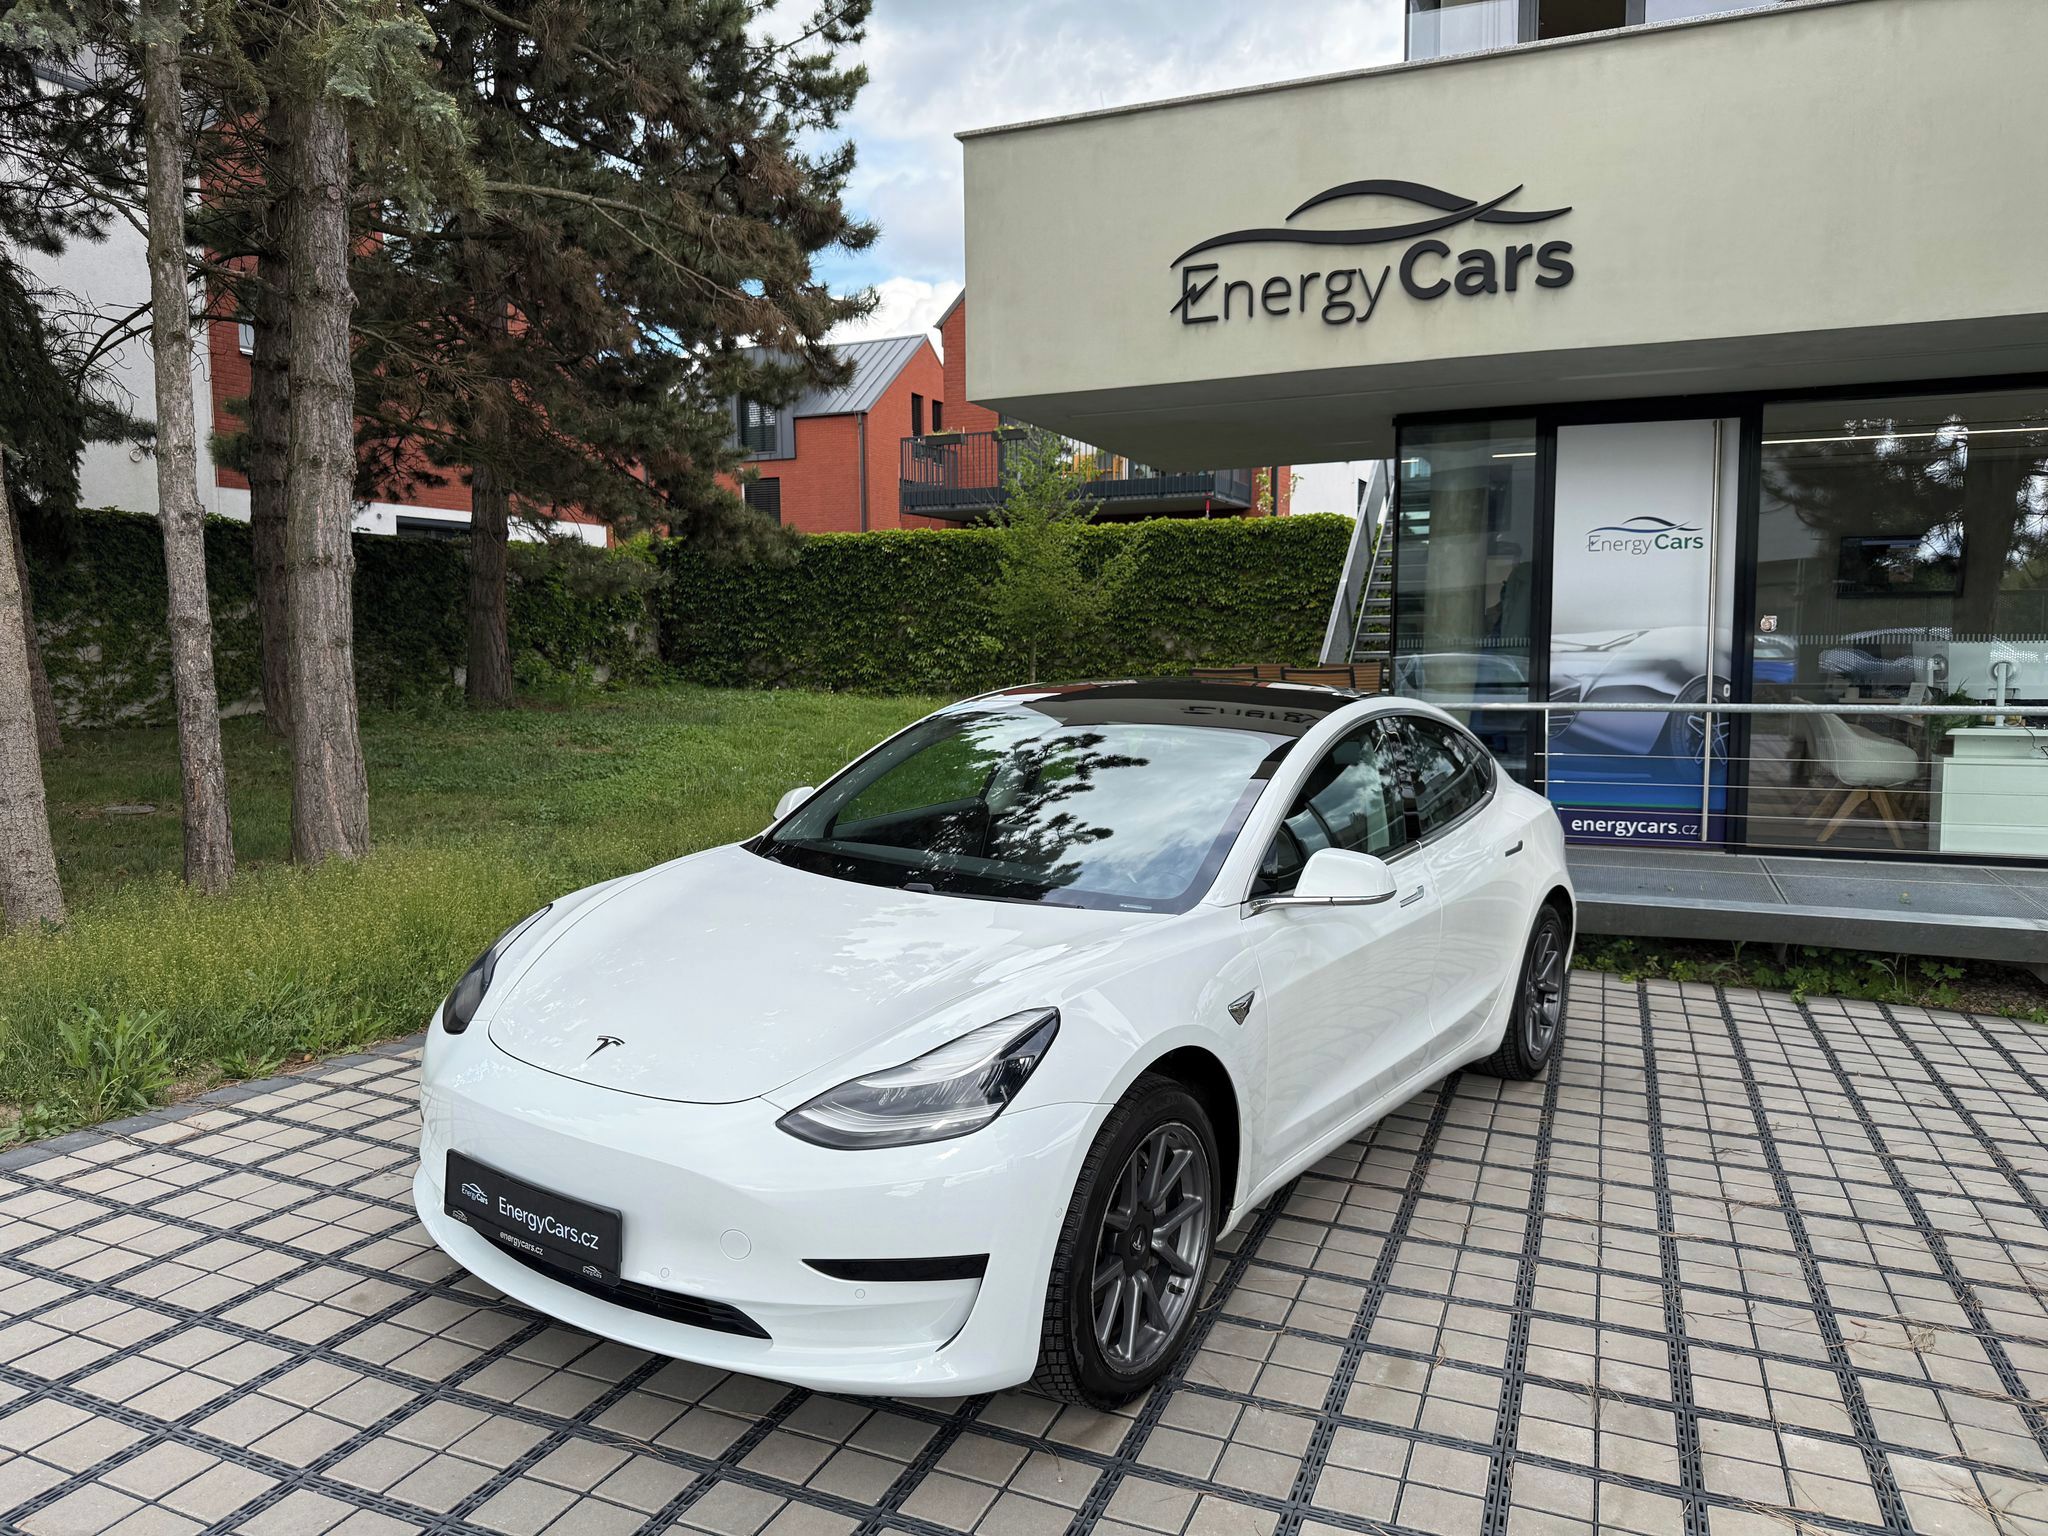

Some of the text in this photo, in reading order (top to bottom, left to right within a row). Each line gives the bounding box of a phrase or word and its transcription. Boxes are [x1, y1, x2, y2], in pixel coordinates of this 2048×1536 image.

[1171, 239, 1575, 325] EnergyCars
[1587, 533, 1704, 555] EnergyCars
[1571, 819, 1698, 837] energycars.cz
[499, 1196, 599, 1250] EnergyCars.cz
[500, 1231, 543, 1255] energycars.cz
